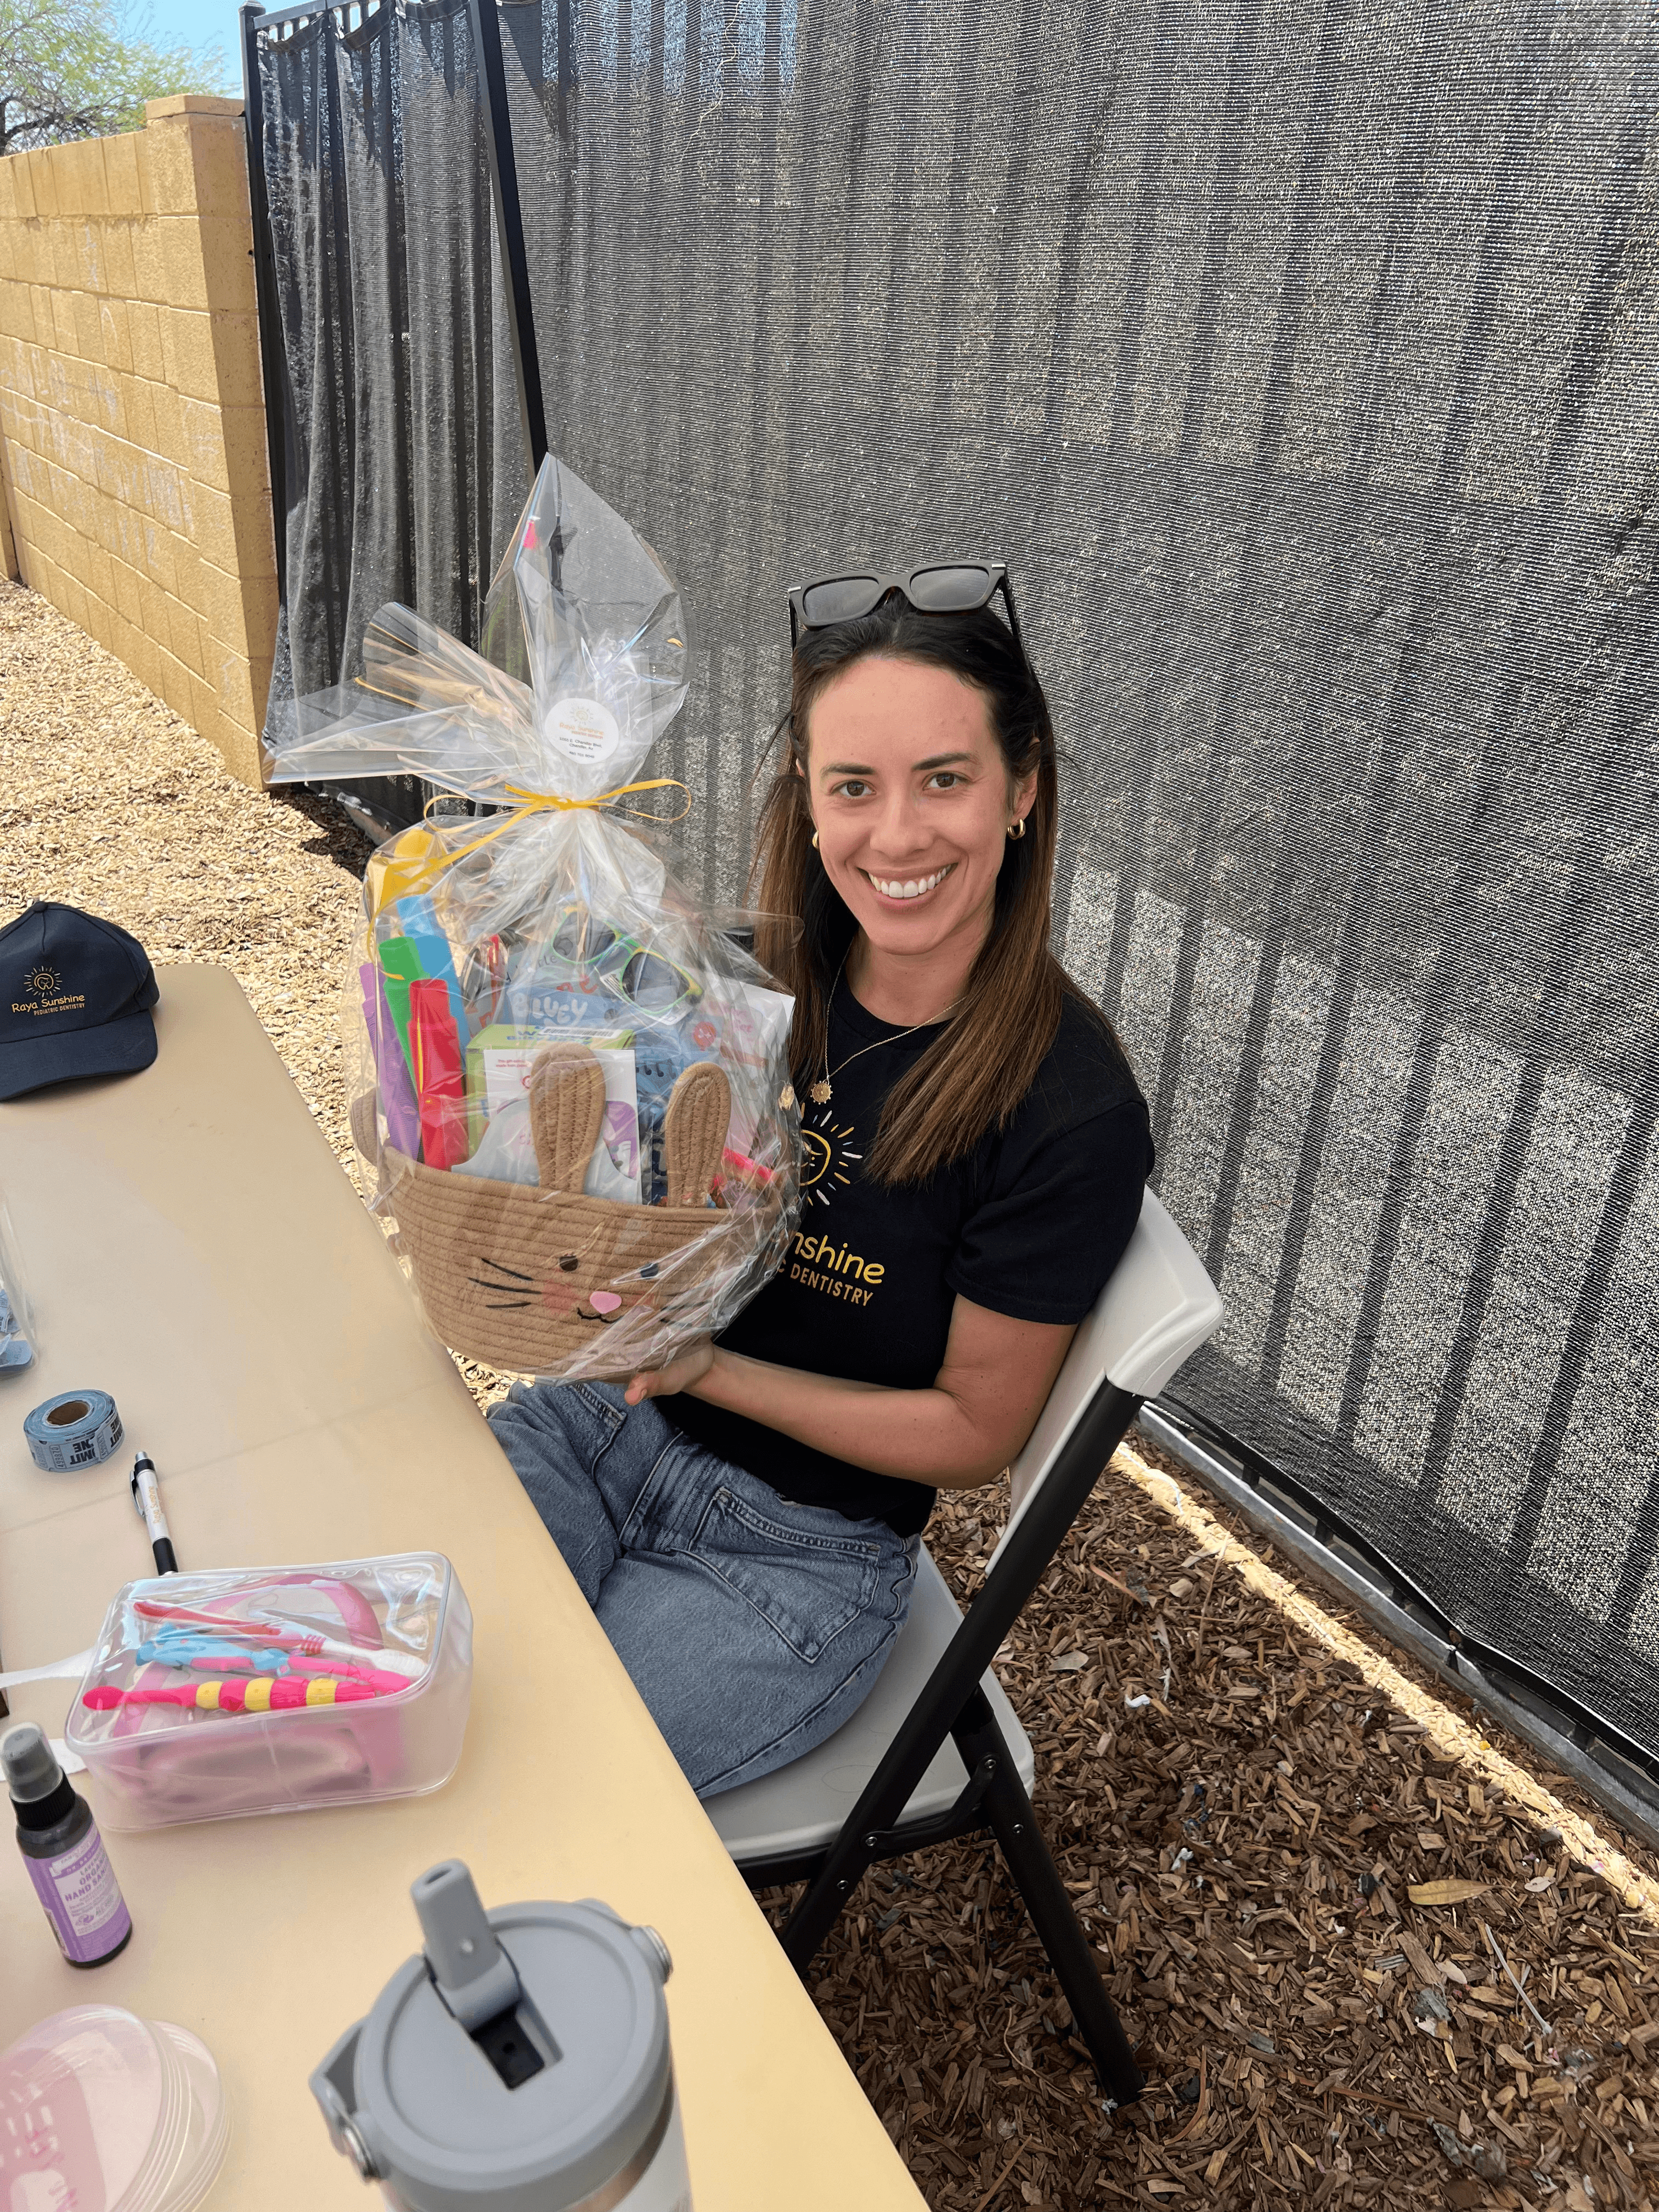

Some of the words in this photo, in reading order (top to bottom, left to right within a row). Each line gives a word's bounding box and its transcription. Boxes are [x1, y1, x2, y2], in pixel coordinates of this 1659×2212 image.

[12, 1002, 38, 1013] Raya
[41, 995, 85, 1007] Sunshine
[33, 1007, 59, 1015] PEDIATRIC
[59, 1003, 85, 1011] DENTISTRY
[794, 1232, 884, 1284] nshine
[790, 1263, 873, 1306] DENTISTRY
[65, 1884, 91, 1901] HAND
